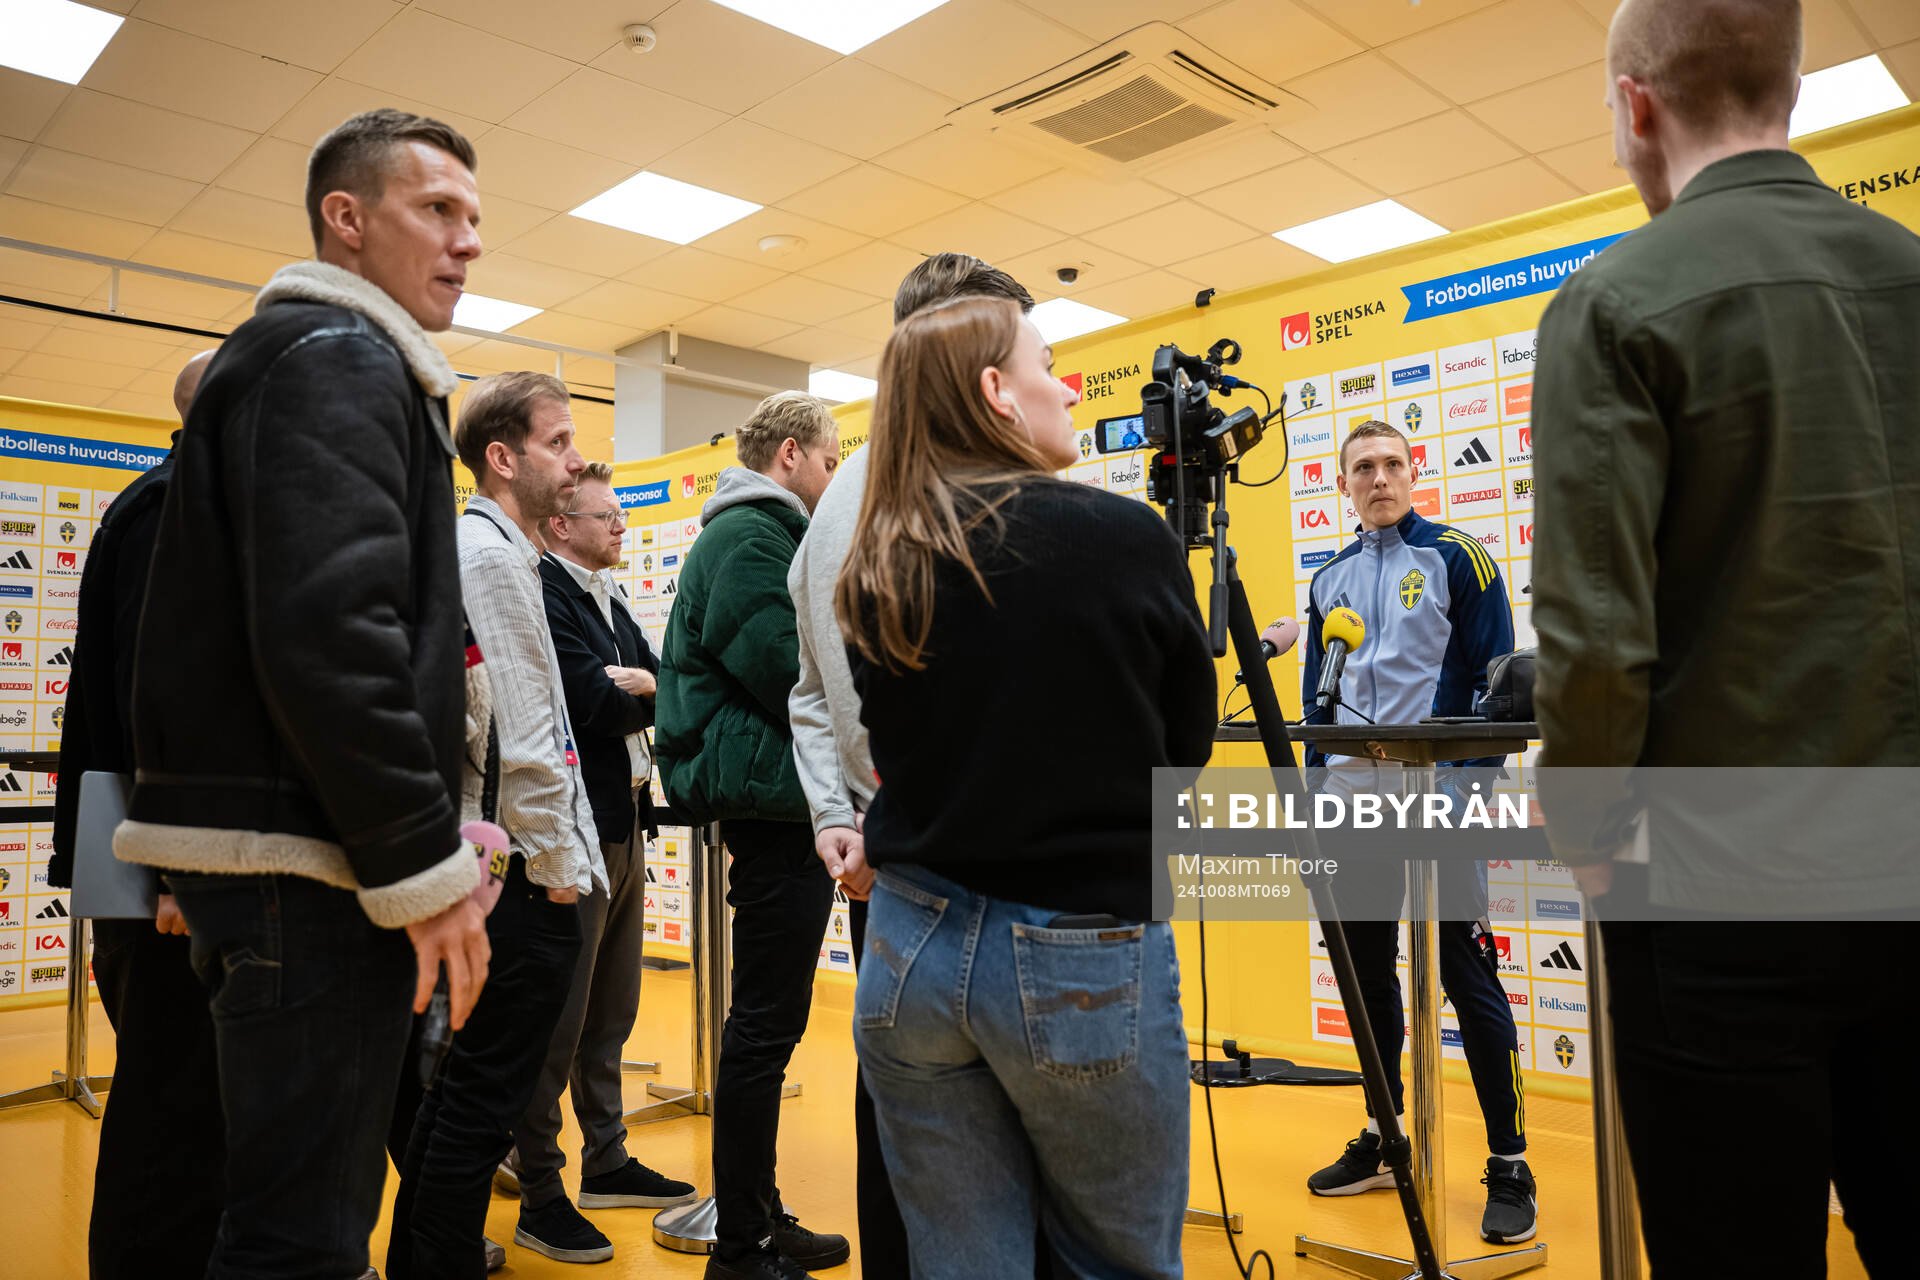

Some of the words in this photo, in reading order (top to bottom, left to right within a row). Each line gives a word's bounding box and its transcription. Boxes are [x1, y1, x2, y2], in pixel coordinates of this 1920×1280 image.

[1838, 165, 1920, 199] ENSKA
[1425, 270, 1527, 307] Fotbollens
[1315, 300, 1386, 329] SVENSKA
[1316, 325, 1353, 344] SPEL
[1444, 356, 1487, 374] Scandic
[1086, 363, 1141, 388] SVENSKA
[1340, 374, 1376, 394] SPORT
[1087, 384, 1115, 401] SPEL
[1293, 431, 1330, 446] Folksam
[1111, 471, 1140, 484] Fabege
[1424, 468, 1440, 477] SPEL
[0, 491, 38, 503] Folksam
[617, 488, 662, 504] dsponsor
[697, 484, 713, 495] SPEL
[1294, 487, 1320, 497] SVENSKA
[1320, 485, 1334, 493] SPEL
[1452, 490, 1501, 504] BAUHAUS
[1300, 508, 1331, 529] ICA
[1, 521, 36, 533] SPORT
[684, 524, 697, 537] ICA
[35, 935, 66, 951] ICA
[31, 966, 66, 979] SPORT
[1539, 996, 1587, 1013] Folksam
